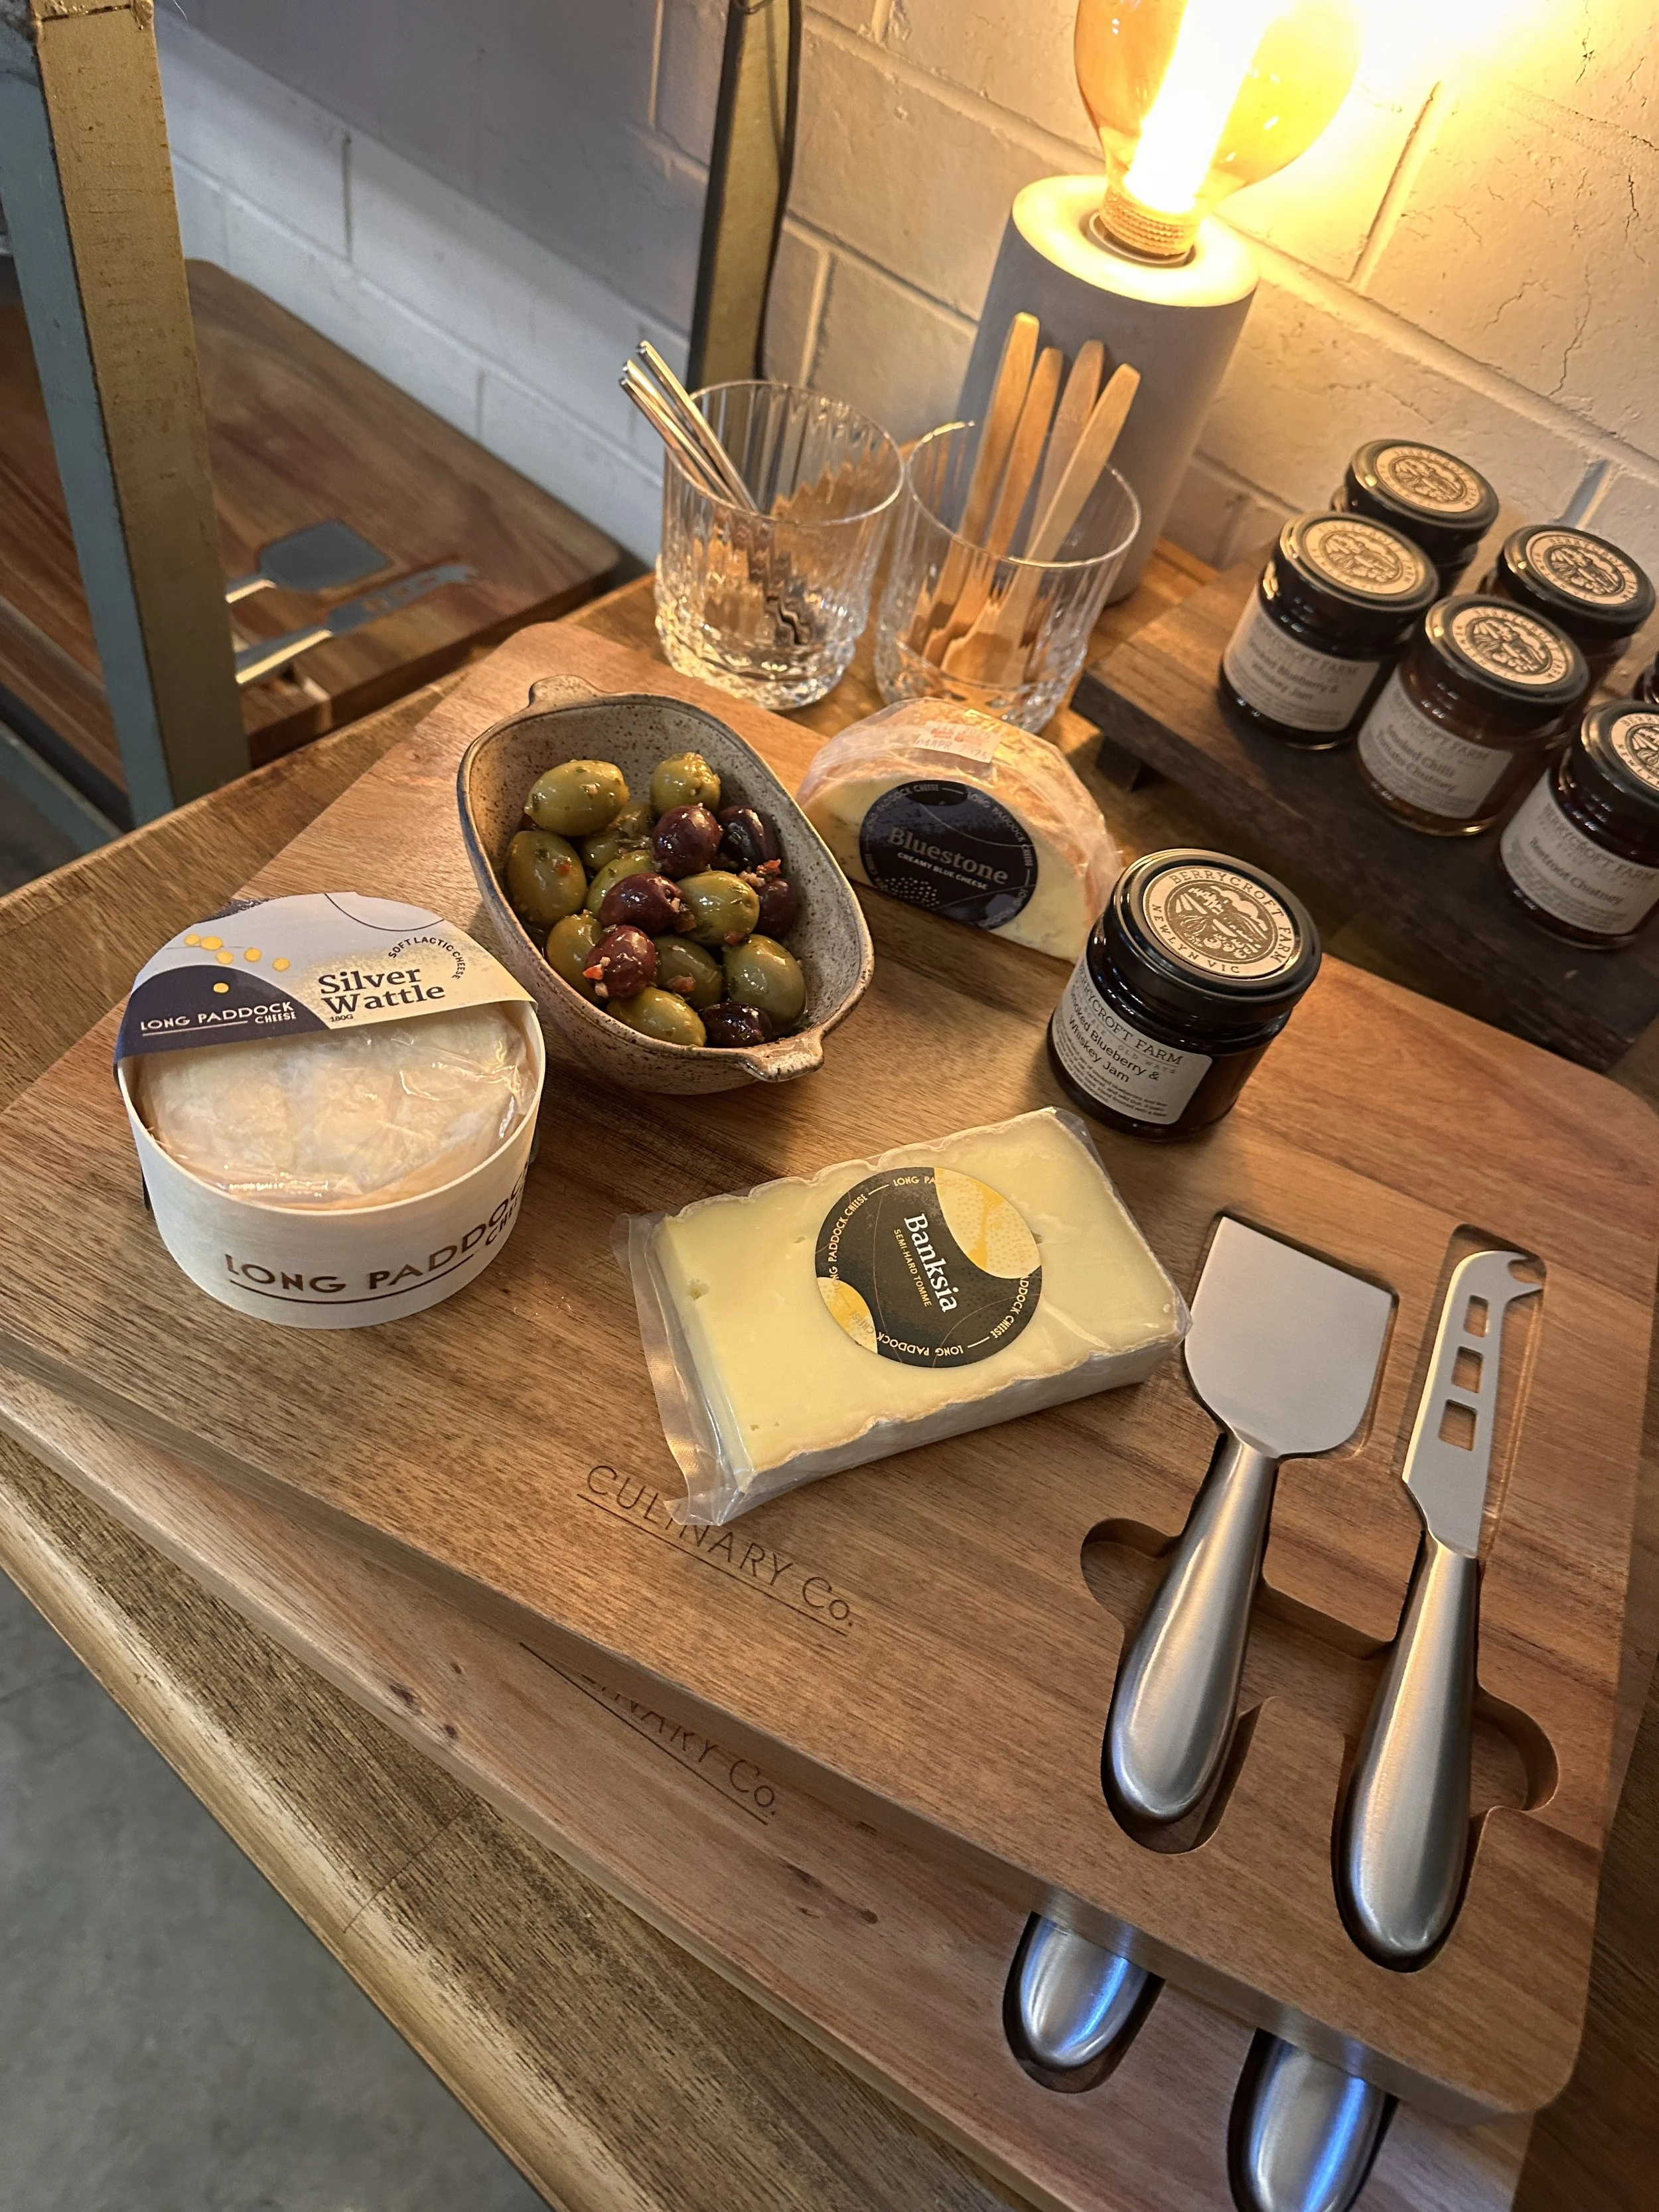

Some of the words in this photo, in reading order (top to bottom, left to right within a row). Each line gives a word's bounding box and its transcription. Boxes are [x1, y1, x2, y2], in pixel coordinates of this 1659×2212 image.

[1621, 715, 1659, 728] BERR
[887, 826, 1009, 885] Bluestone
[897, 851, 932, 869] CREAMY
[932, 865, 956, 879] BLUE
[955, 873, 988, 891] CHEESE
[1169, 870, 1285, 918] BERRYCROFT
[1271, 926, 1292, 964] FARM
[388, 938, 411, 958] SOFT
[413, 936, 454, 952] LACTIC
[452, 951, 466, 980] CHEESE
[1152, 904, 1199, 960] NEWLYN
[1207, 960, 1240, 974] VIC
[318, 968, 422, 994] Silver
[321, 983, 446, 1015] Wattle
[139, 1015, 190, 1031] LONG
[198, 1001, 295, 1024] PADDOCK
[254, 1011, 297, 1025] CHEESE
[330, 1013, 354, 1023] 180G
[1069, 1014, 1102, 1063] Whiskey
[1102, 1061, 1129, 1083] Jam
[1090, 1029, 1147, 1076] Blueberry
[1148, 1070, 1160, 1081] &
[1134, 1039, 1184, 1065] FARM
[893, 1175, 920, 1187] LONG
[828, 1215, 849, 1263] PADDOCK
[844, 1193, 868, 1217] CHEESE
[224, 1252, 347, 1294] LONG
[893, 1228, 918, 1276] SEMI-HARD
[912, 1275, 932, 1308] TOMME
[903, 1213, 958, 1313] Banksia
[876, 1331, 930, 1356] PADDOCK
[989, 1314, 1015, 1339] CHEESE
[934, 1345, 964, 1357] LONG
[802, 1576, 854, 1627] Co.
[729, 1759, 777, 1816] Co.
